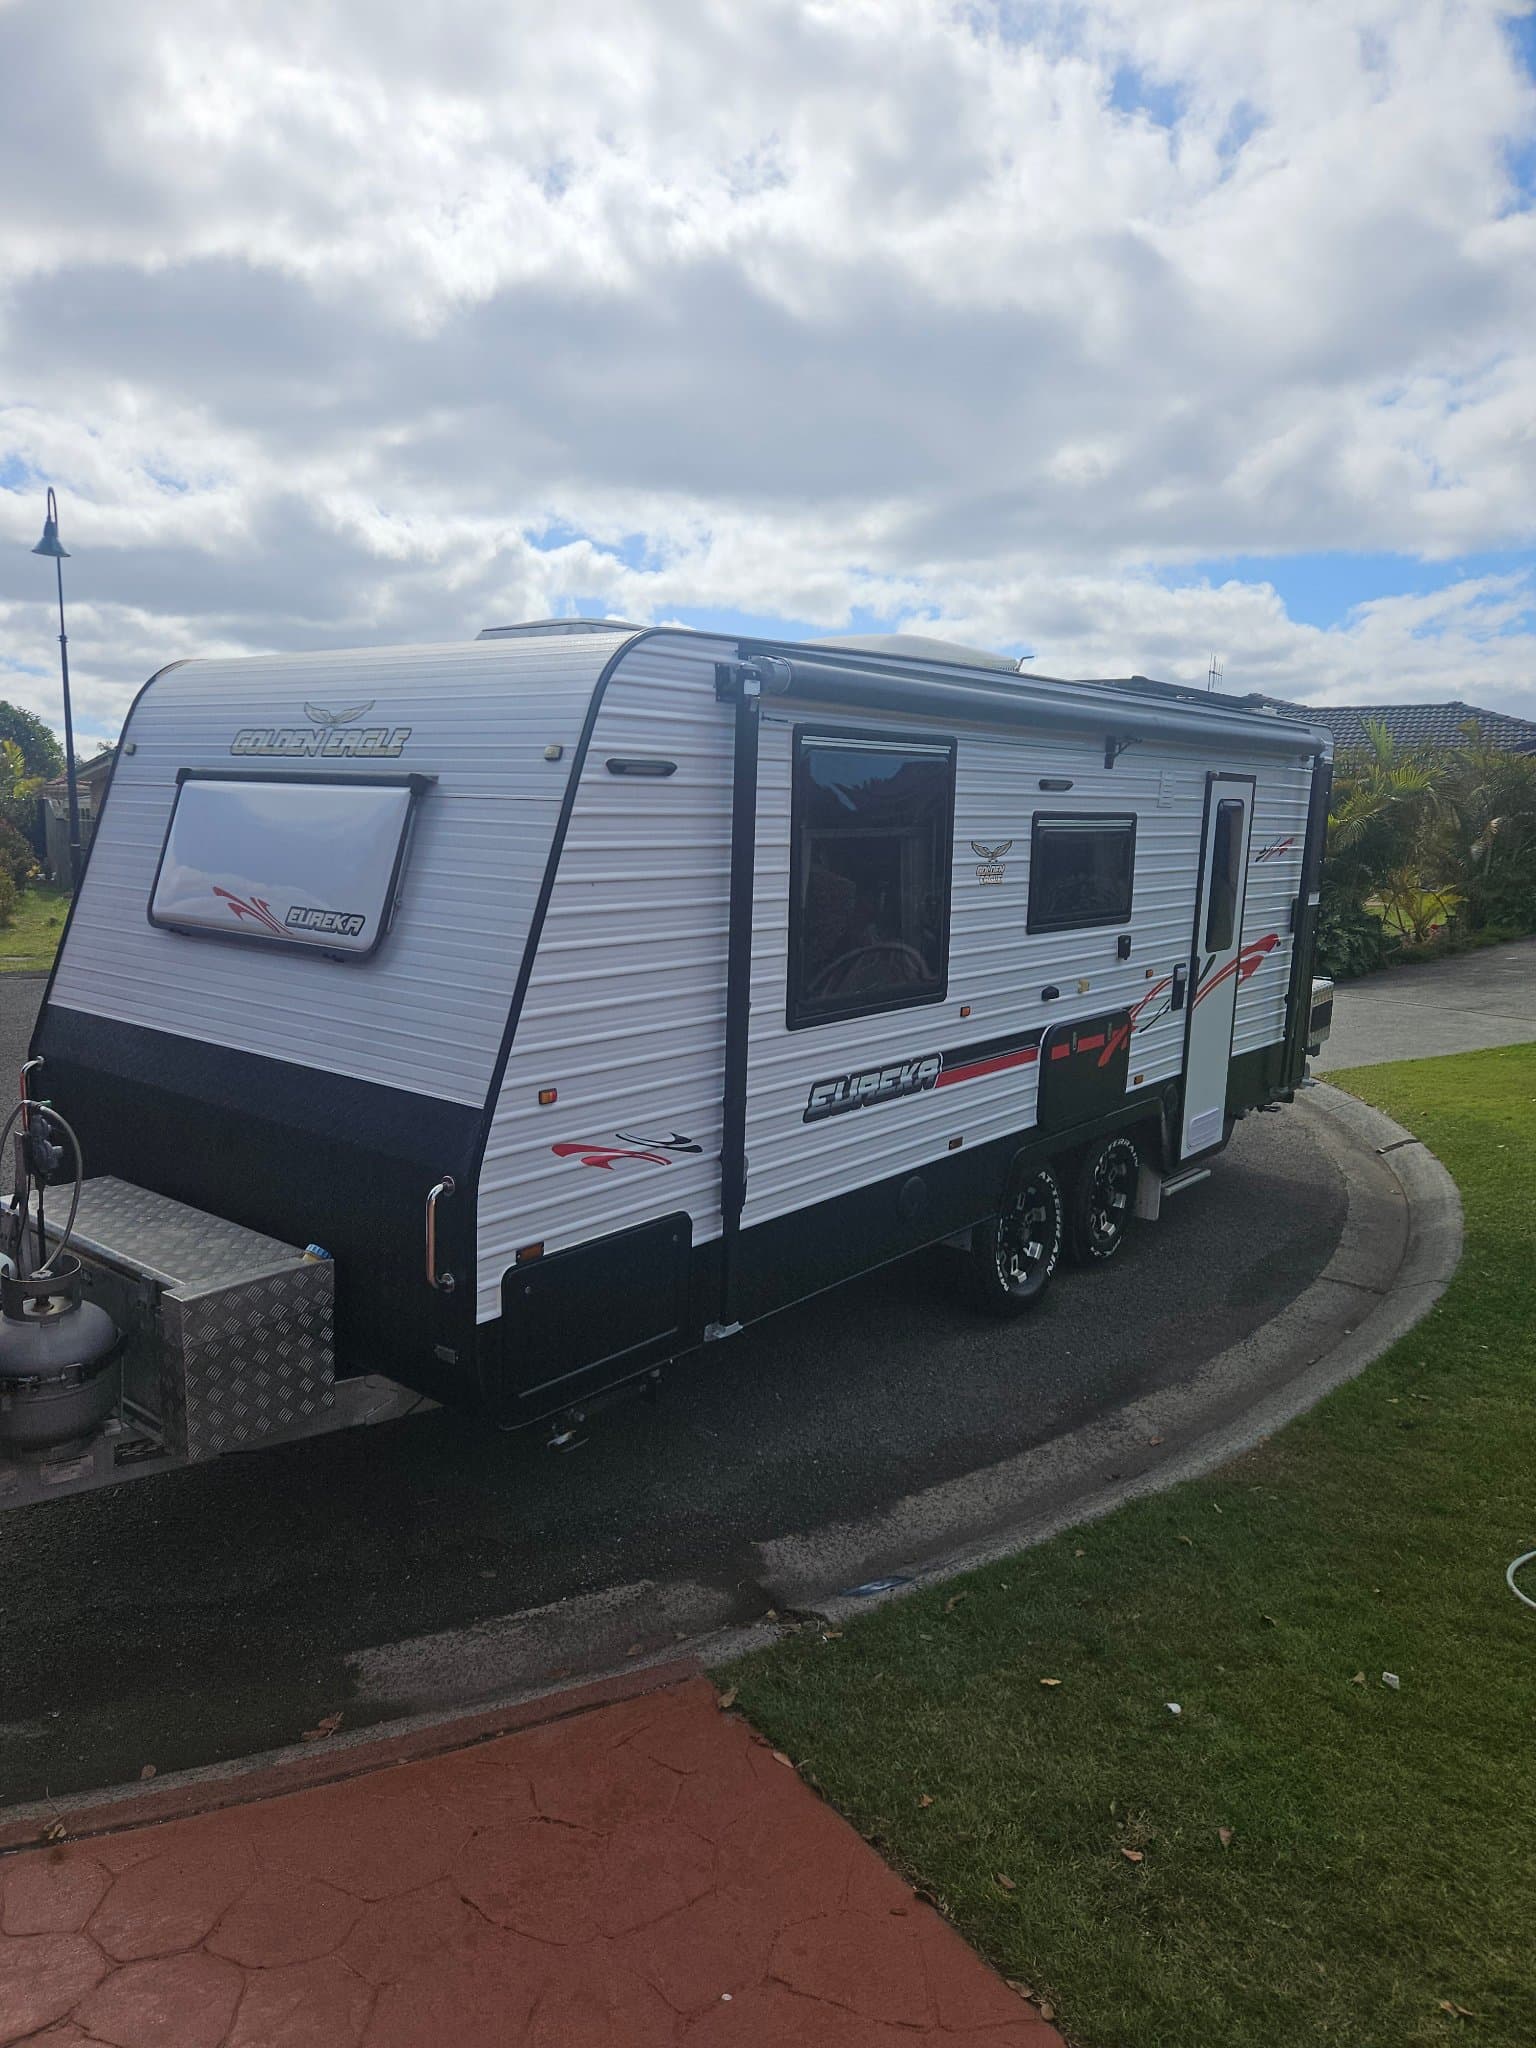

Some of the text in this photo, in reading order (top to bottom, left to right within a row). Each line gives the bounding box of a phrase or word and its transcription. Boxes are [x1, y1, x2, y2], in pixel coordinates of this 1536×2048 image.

[231, 728, 412, 757] GOLDEN EAGLE
[976, 864, 1005, 876] GOLDEN
[286, 907, 365, 935] EUREKA
[804, 1054, 942, 1122] EUREKA
